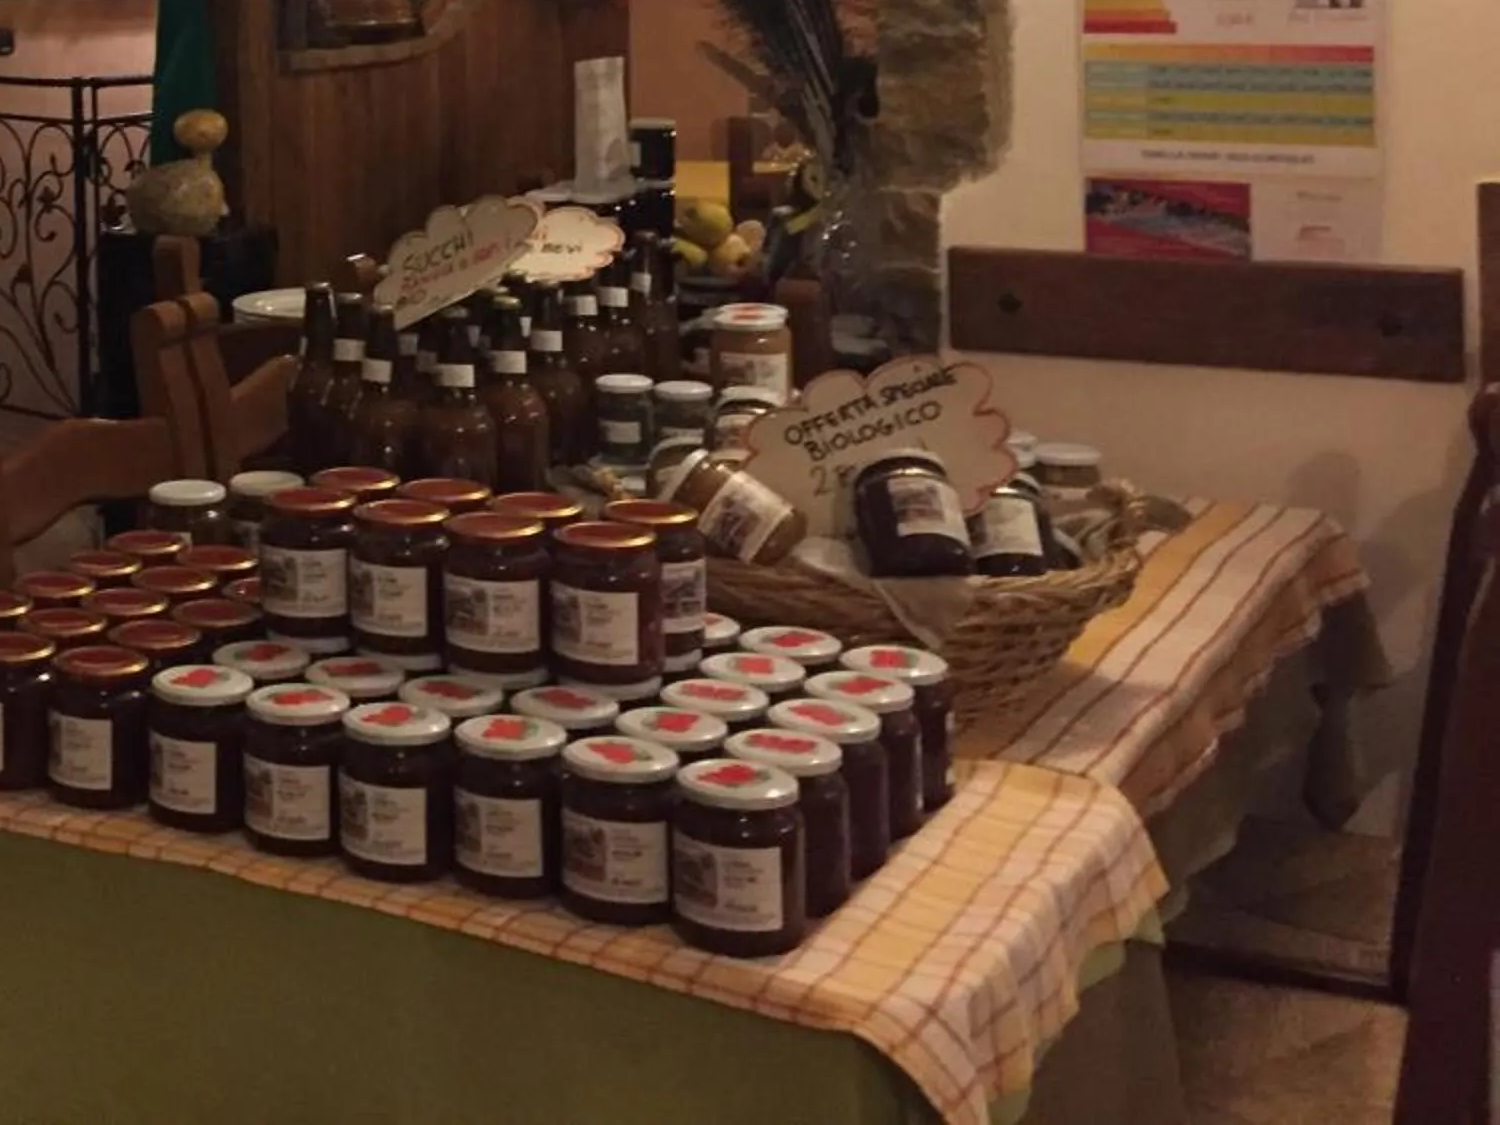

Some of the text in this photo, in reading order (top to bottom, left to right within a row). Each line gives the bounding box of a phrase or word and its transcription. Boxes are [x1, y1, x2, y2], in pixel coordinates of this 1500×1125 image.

[402, 230, 474, 273] SUCCHI
[784, 393, 877, 446] OFFERTA
[803, 400, 942, 462] BIOLOGICO
